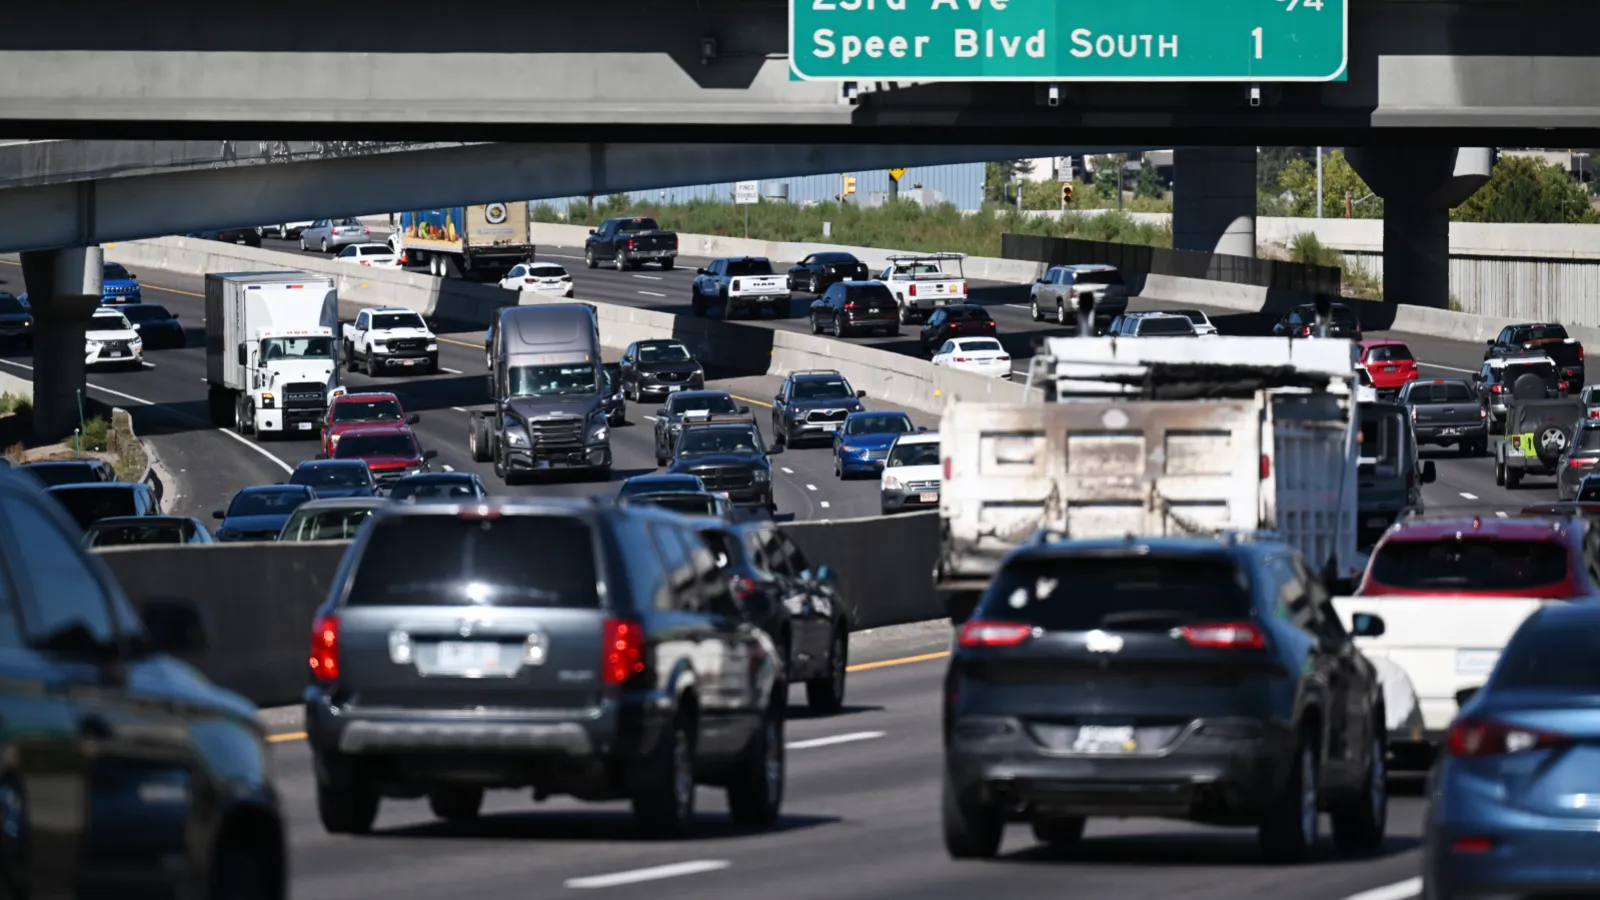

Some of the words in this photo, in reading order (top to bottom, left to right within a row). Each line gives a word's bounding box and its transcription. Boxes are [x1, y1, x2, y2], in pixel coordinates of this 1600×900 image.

[812, 28, 930, 64] Speer
[954, 28, 1045, 57] Blvd
[1070, 28, 1178, 58] SOUTH
[1251, 27, 1263, 59] 1
